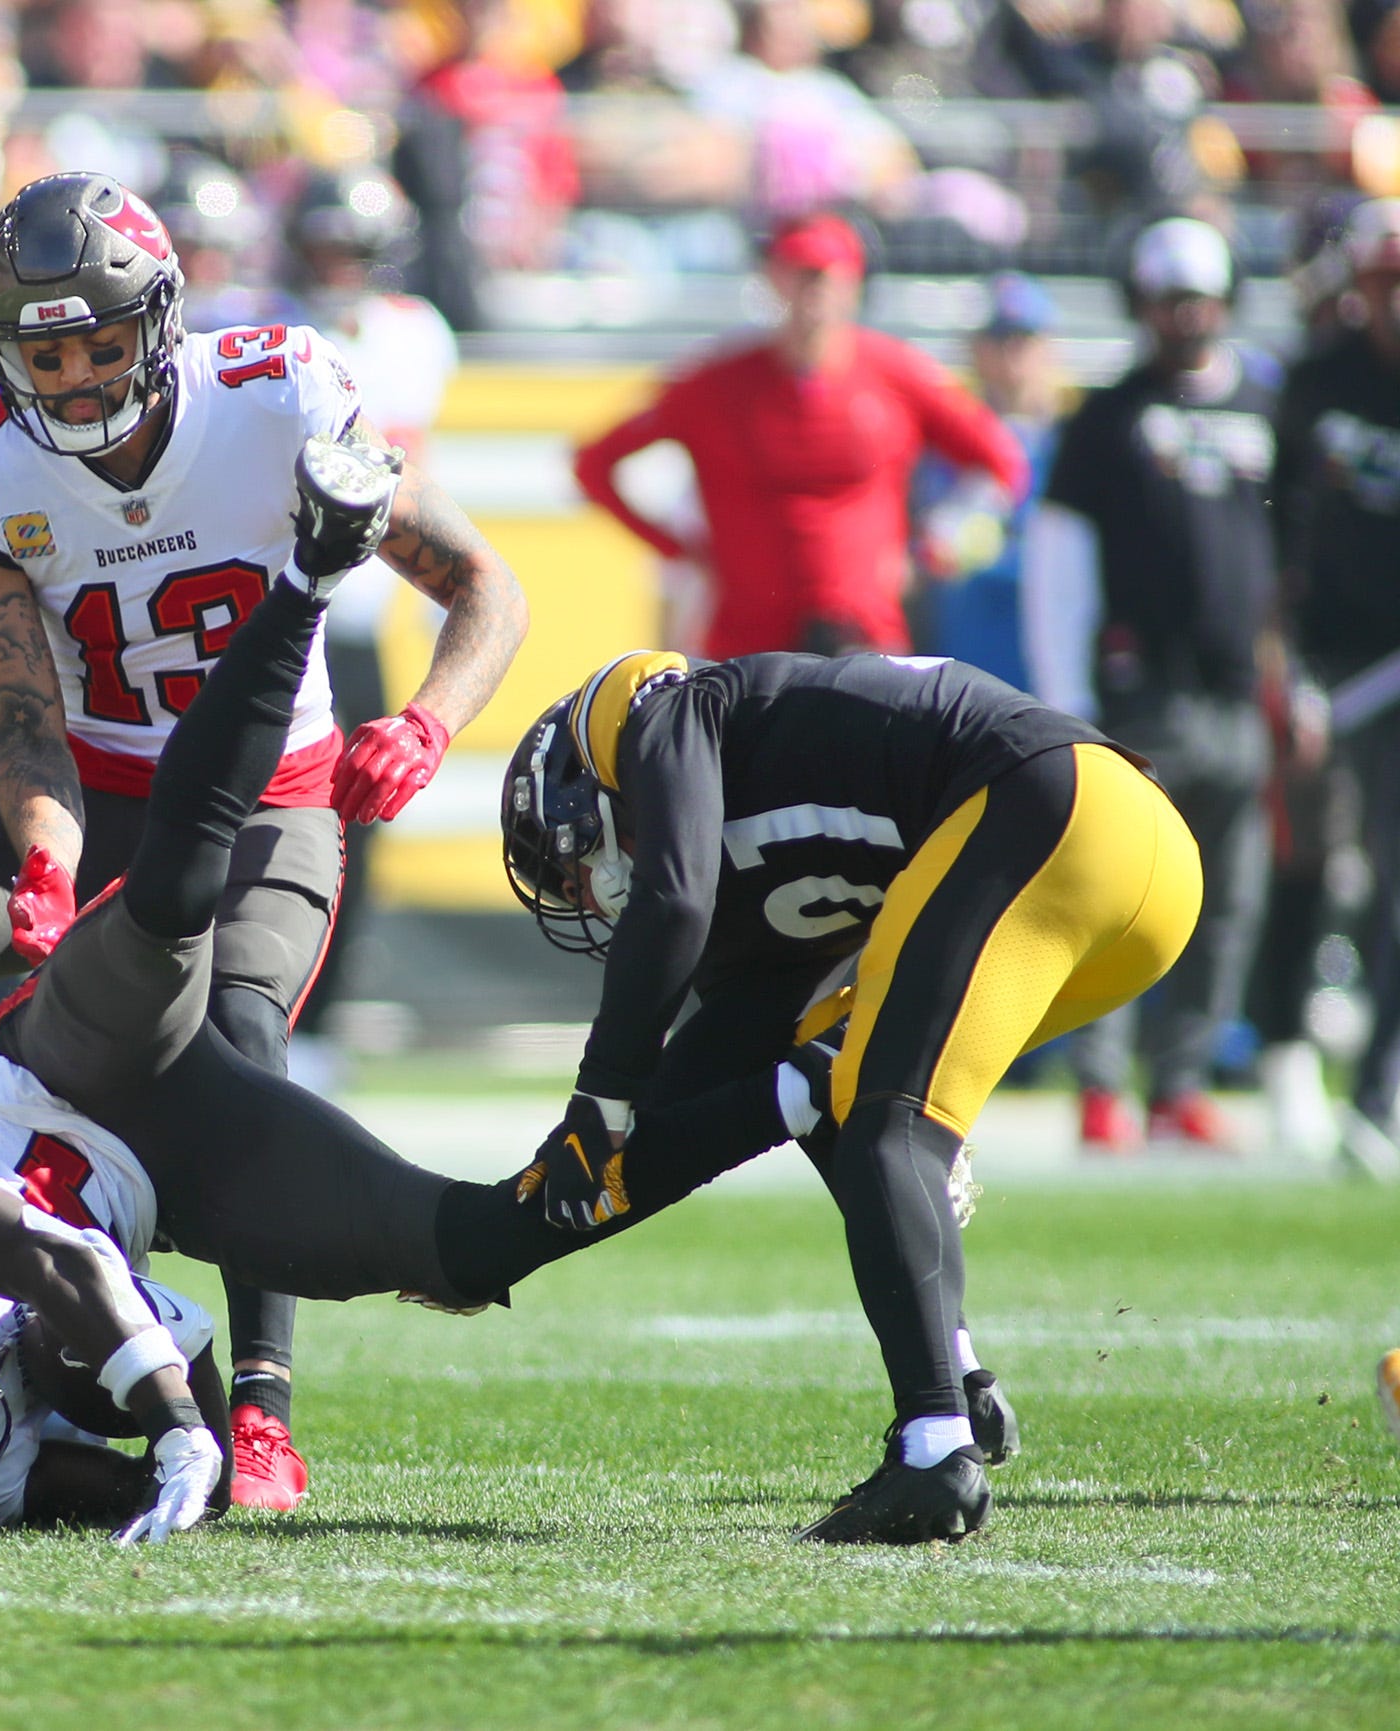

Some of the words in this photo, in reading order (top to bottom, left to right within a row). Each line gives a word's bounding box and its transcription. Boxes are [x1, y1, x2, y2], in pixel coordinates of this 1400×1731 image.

[217, 323, 287, 389] 13
[93, 530, 198, 567] BUCCANEERS
[64, 559, 269, 727] 13
